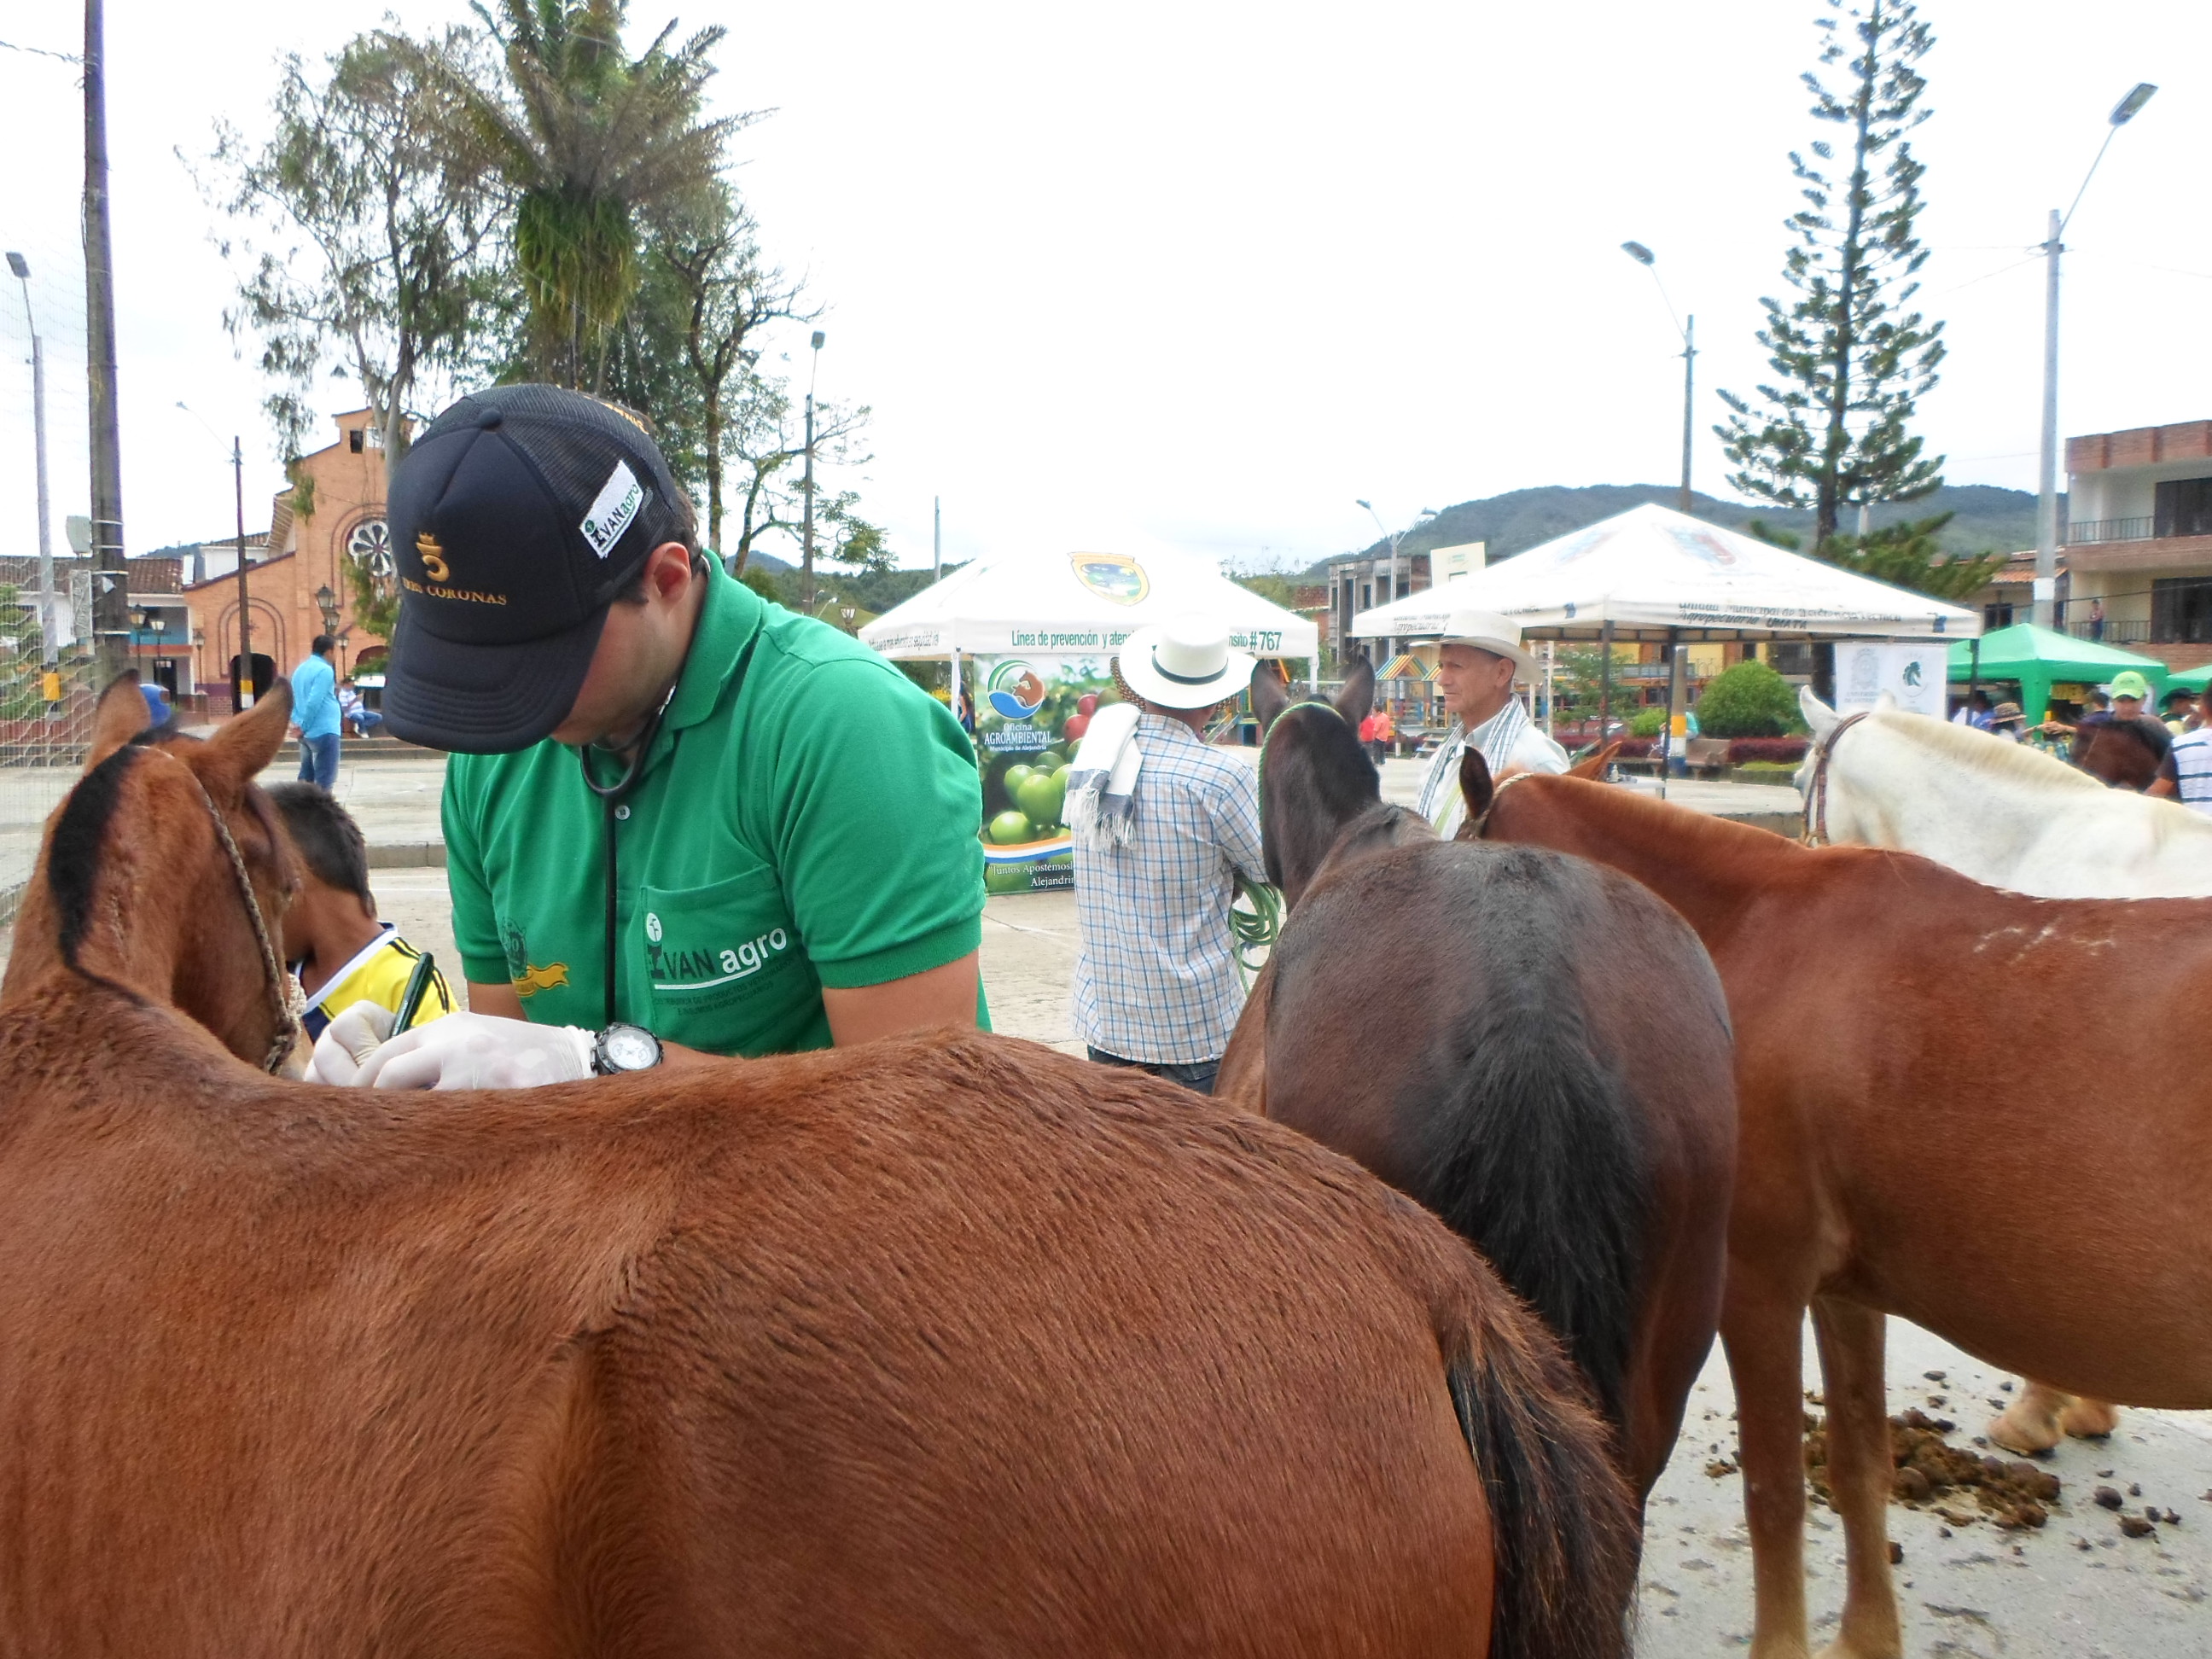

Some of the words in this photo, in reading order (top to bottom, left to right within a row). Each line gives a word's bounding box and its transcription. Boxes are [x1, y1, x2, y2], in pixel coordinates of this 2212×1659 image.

[427, 585, 507, 605] CORONAS
[1766, 618, 1807, 629] UMATA
[1011, 630, 1035, 646] Línea
[1038, 631, 1048, 646] de
[1051, 630, 1098, 649] prevención
[1102, 633, 1108, 649] y
[1109, 630, 1132, 646] aten
[1229, 632, 1248, 647] nsito
[1003, 723, 1032, 731] Oficina
[984, 731, 1052, 745] AGROAMBIENTAL
[719, 928, 787, 974] agro
